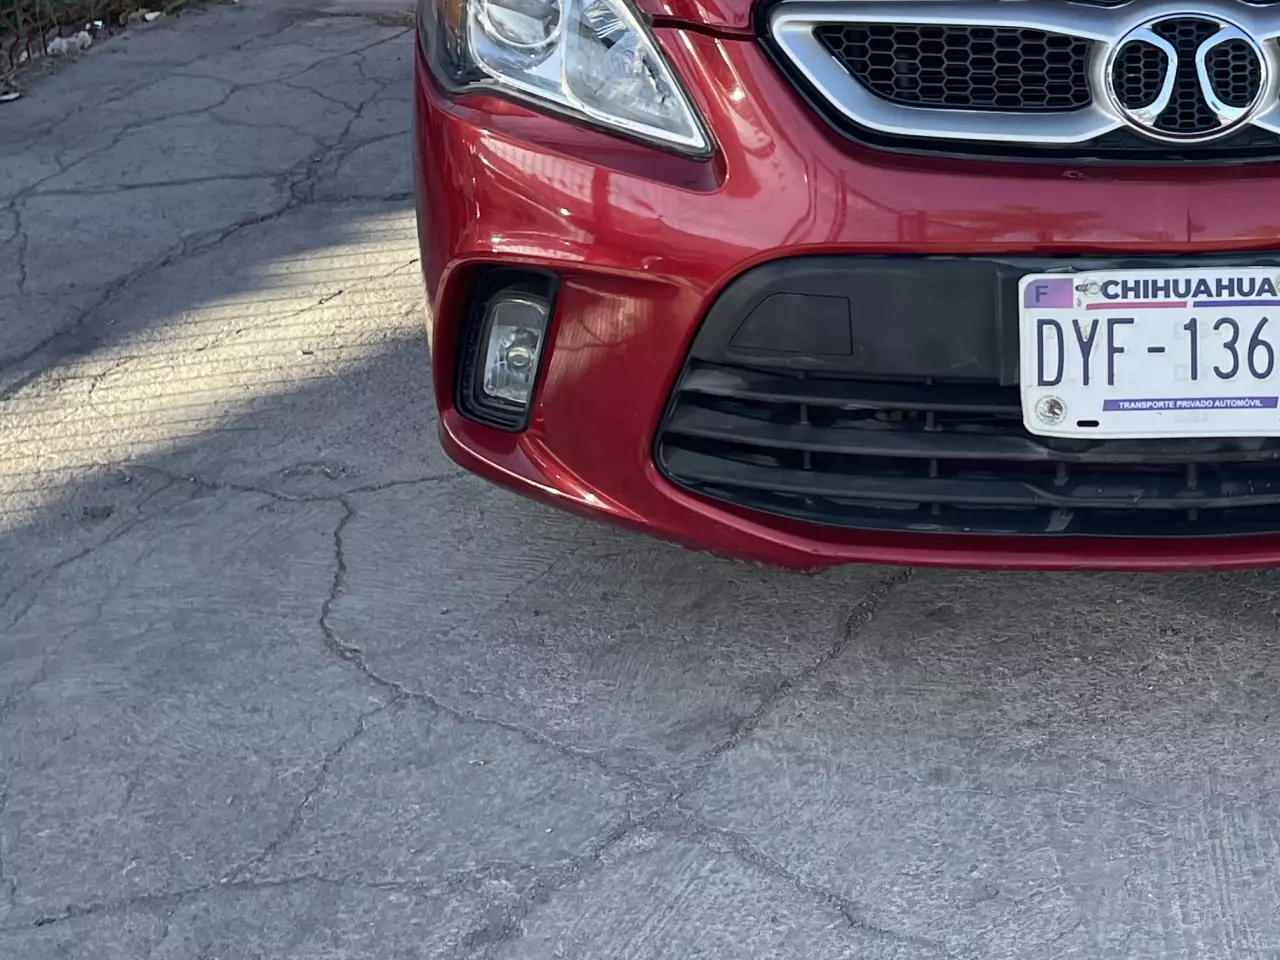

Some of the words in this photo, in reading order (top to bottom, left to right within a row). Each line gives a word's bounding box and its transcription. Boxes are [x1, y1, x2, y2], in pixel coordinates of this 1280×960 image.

[1035, 285, 1048, 302] F
[1101, 278, 1278, 300] CHIHUAHUA
[1119, 400, 1175, 409] TRANSPORTE
[1176, 399, 1213, 408] PRIVADO
[1214, 398, 1263, 408] AUTOMÓVIL
